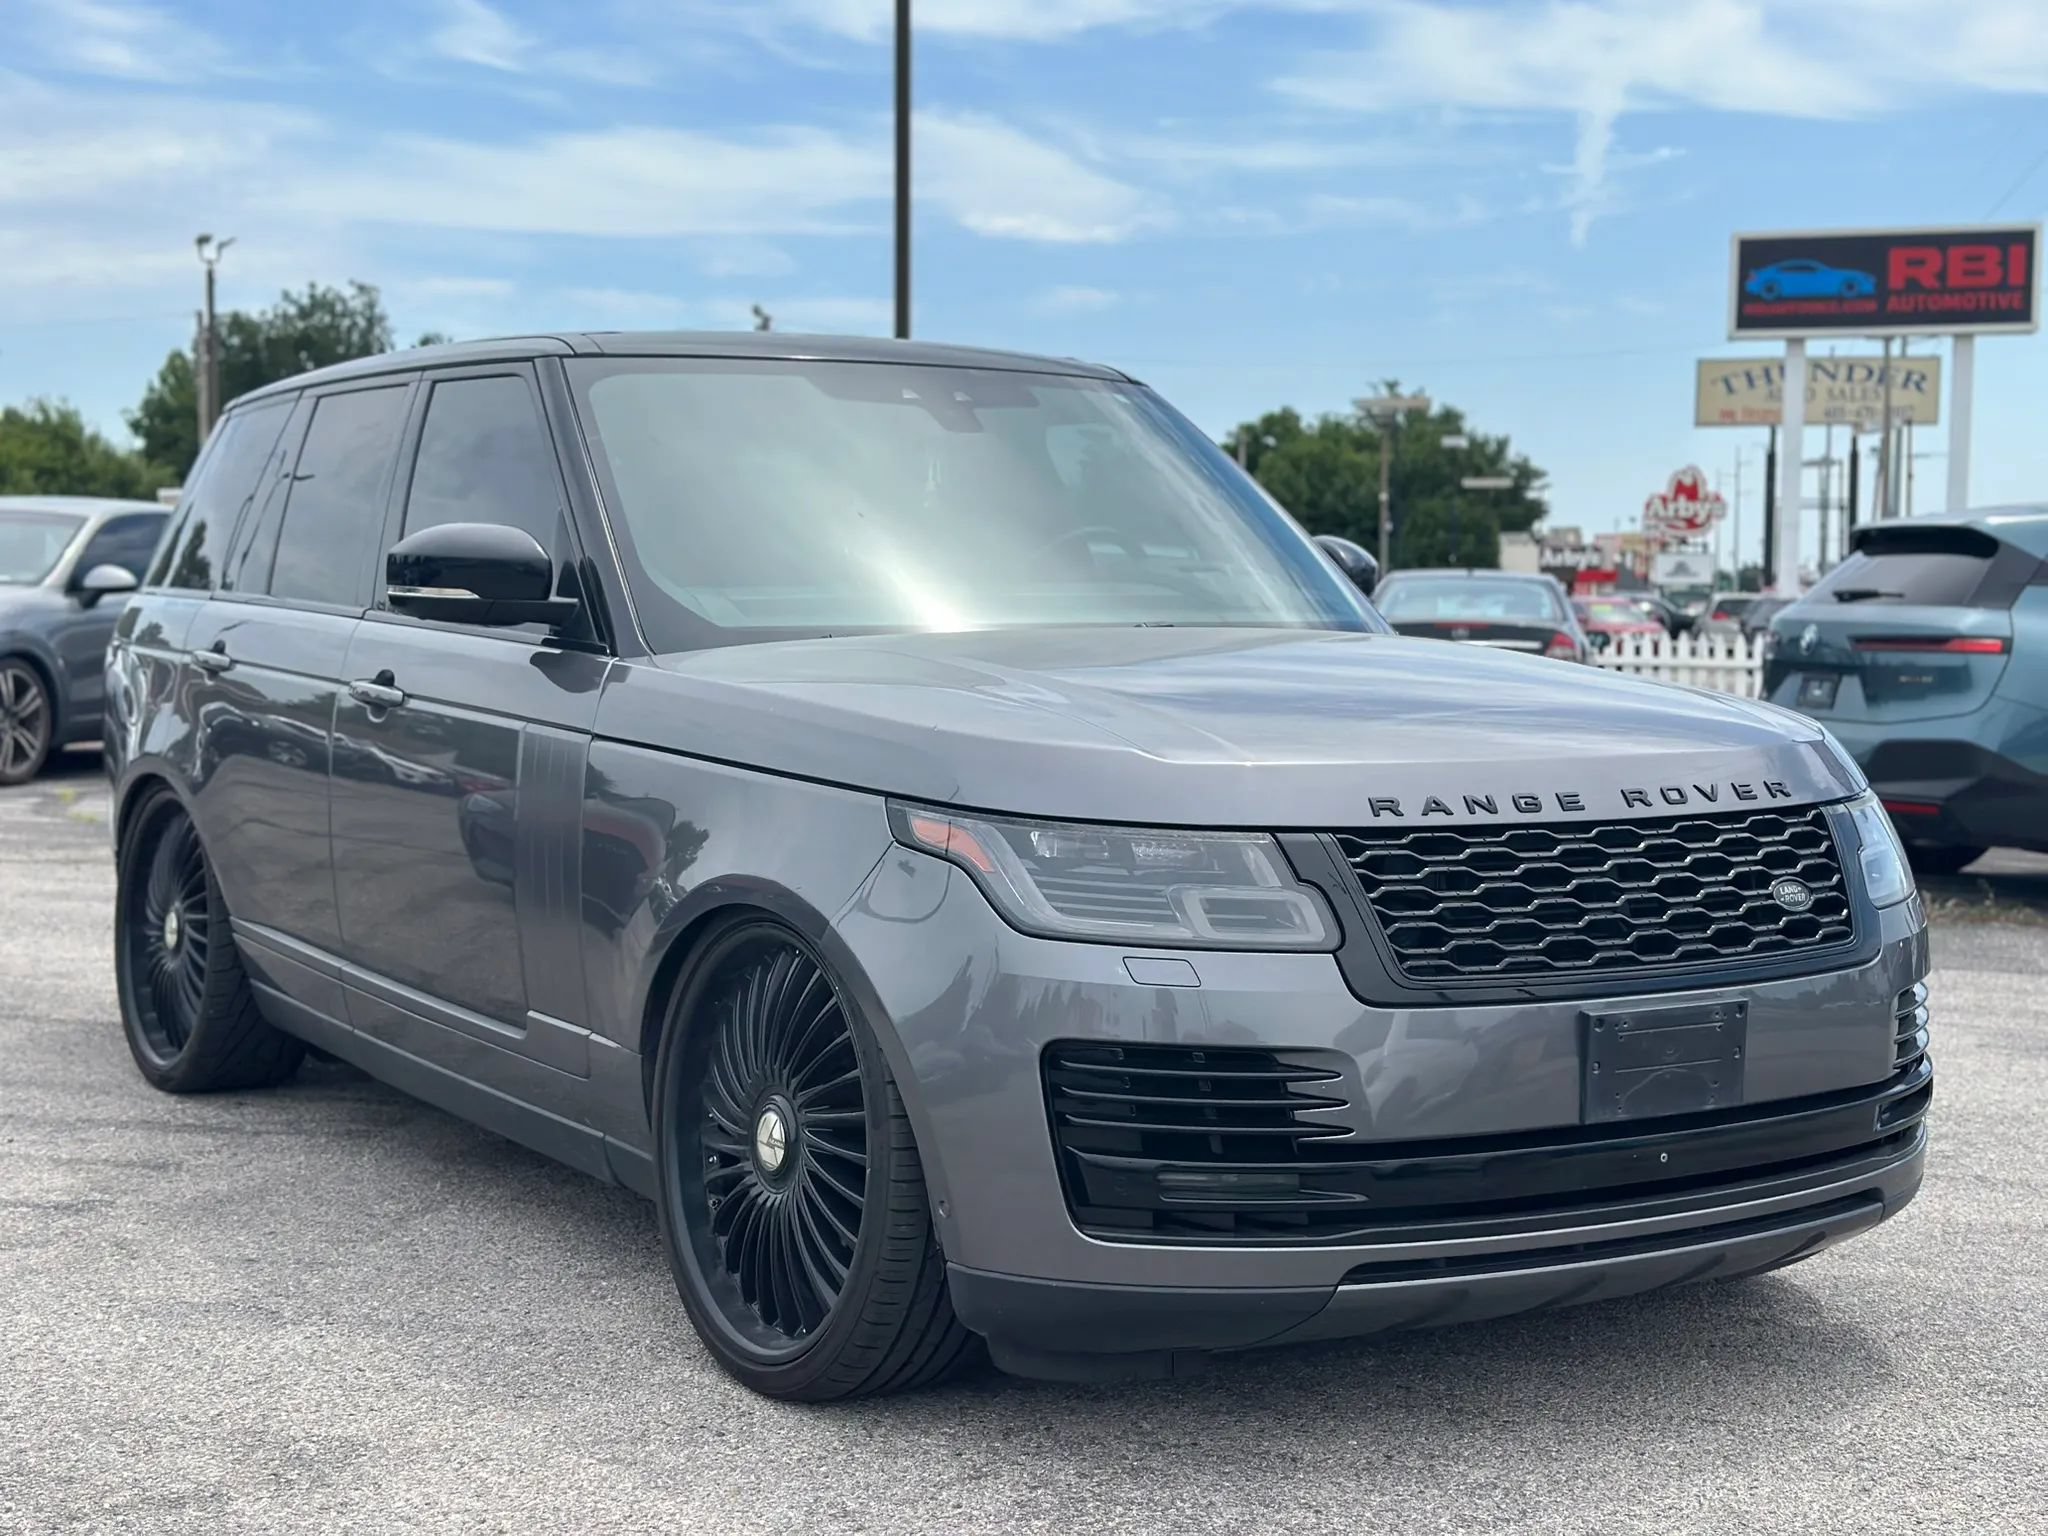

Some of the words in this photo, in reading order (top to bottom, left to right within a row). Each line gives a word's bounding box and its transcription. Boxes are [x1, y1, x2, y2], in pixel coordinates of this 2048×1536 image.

[1887, 244, 2027, 290] RBI
[1886, 290, 2024, 314] AUTOMOTIVE
[1648, 494, 1726, 525] Arby's
[1368, 790, 1586, 818] RANGE
[1620, 779, 1793, 808] ROVER
[1779, 885, 1798, 895] LAND
[1784, 893, 1806, 902] ROVER
